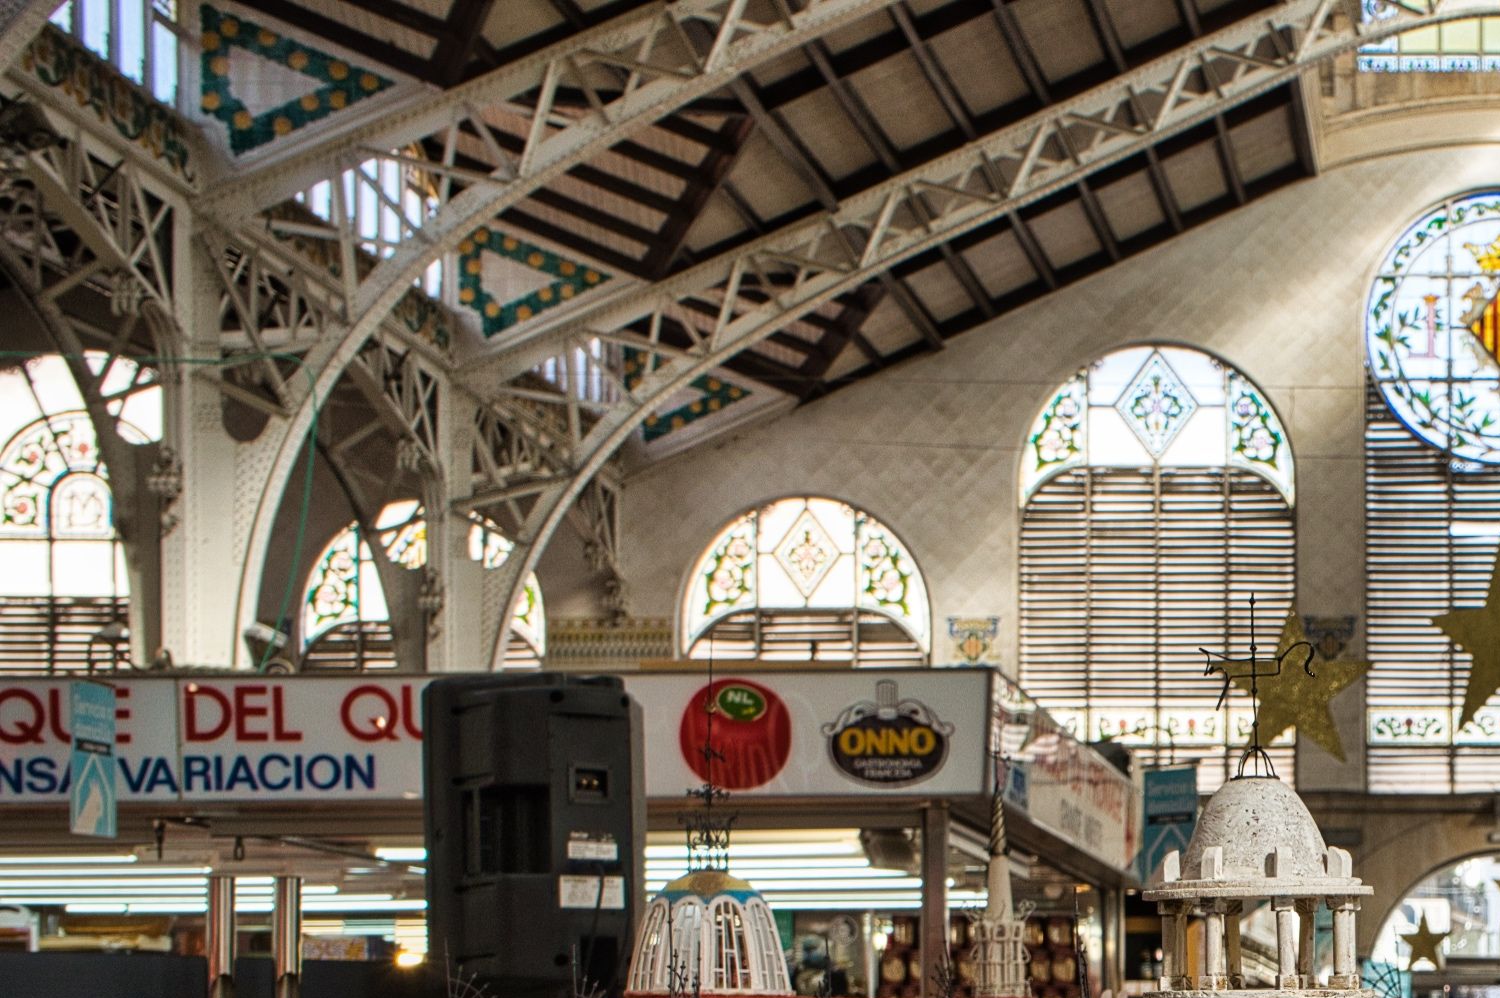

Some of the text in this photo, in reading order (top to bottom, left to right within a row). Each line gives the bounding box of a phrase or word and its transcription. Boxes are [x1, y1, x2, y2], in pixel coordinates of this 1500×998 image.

[183, 684, 303, 742] DEL
[727, 690, 754, 706] NL
[839, 726, 936, 756] ONNO
[117, 753, 376, 794] VARIACION
